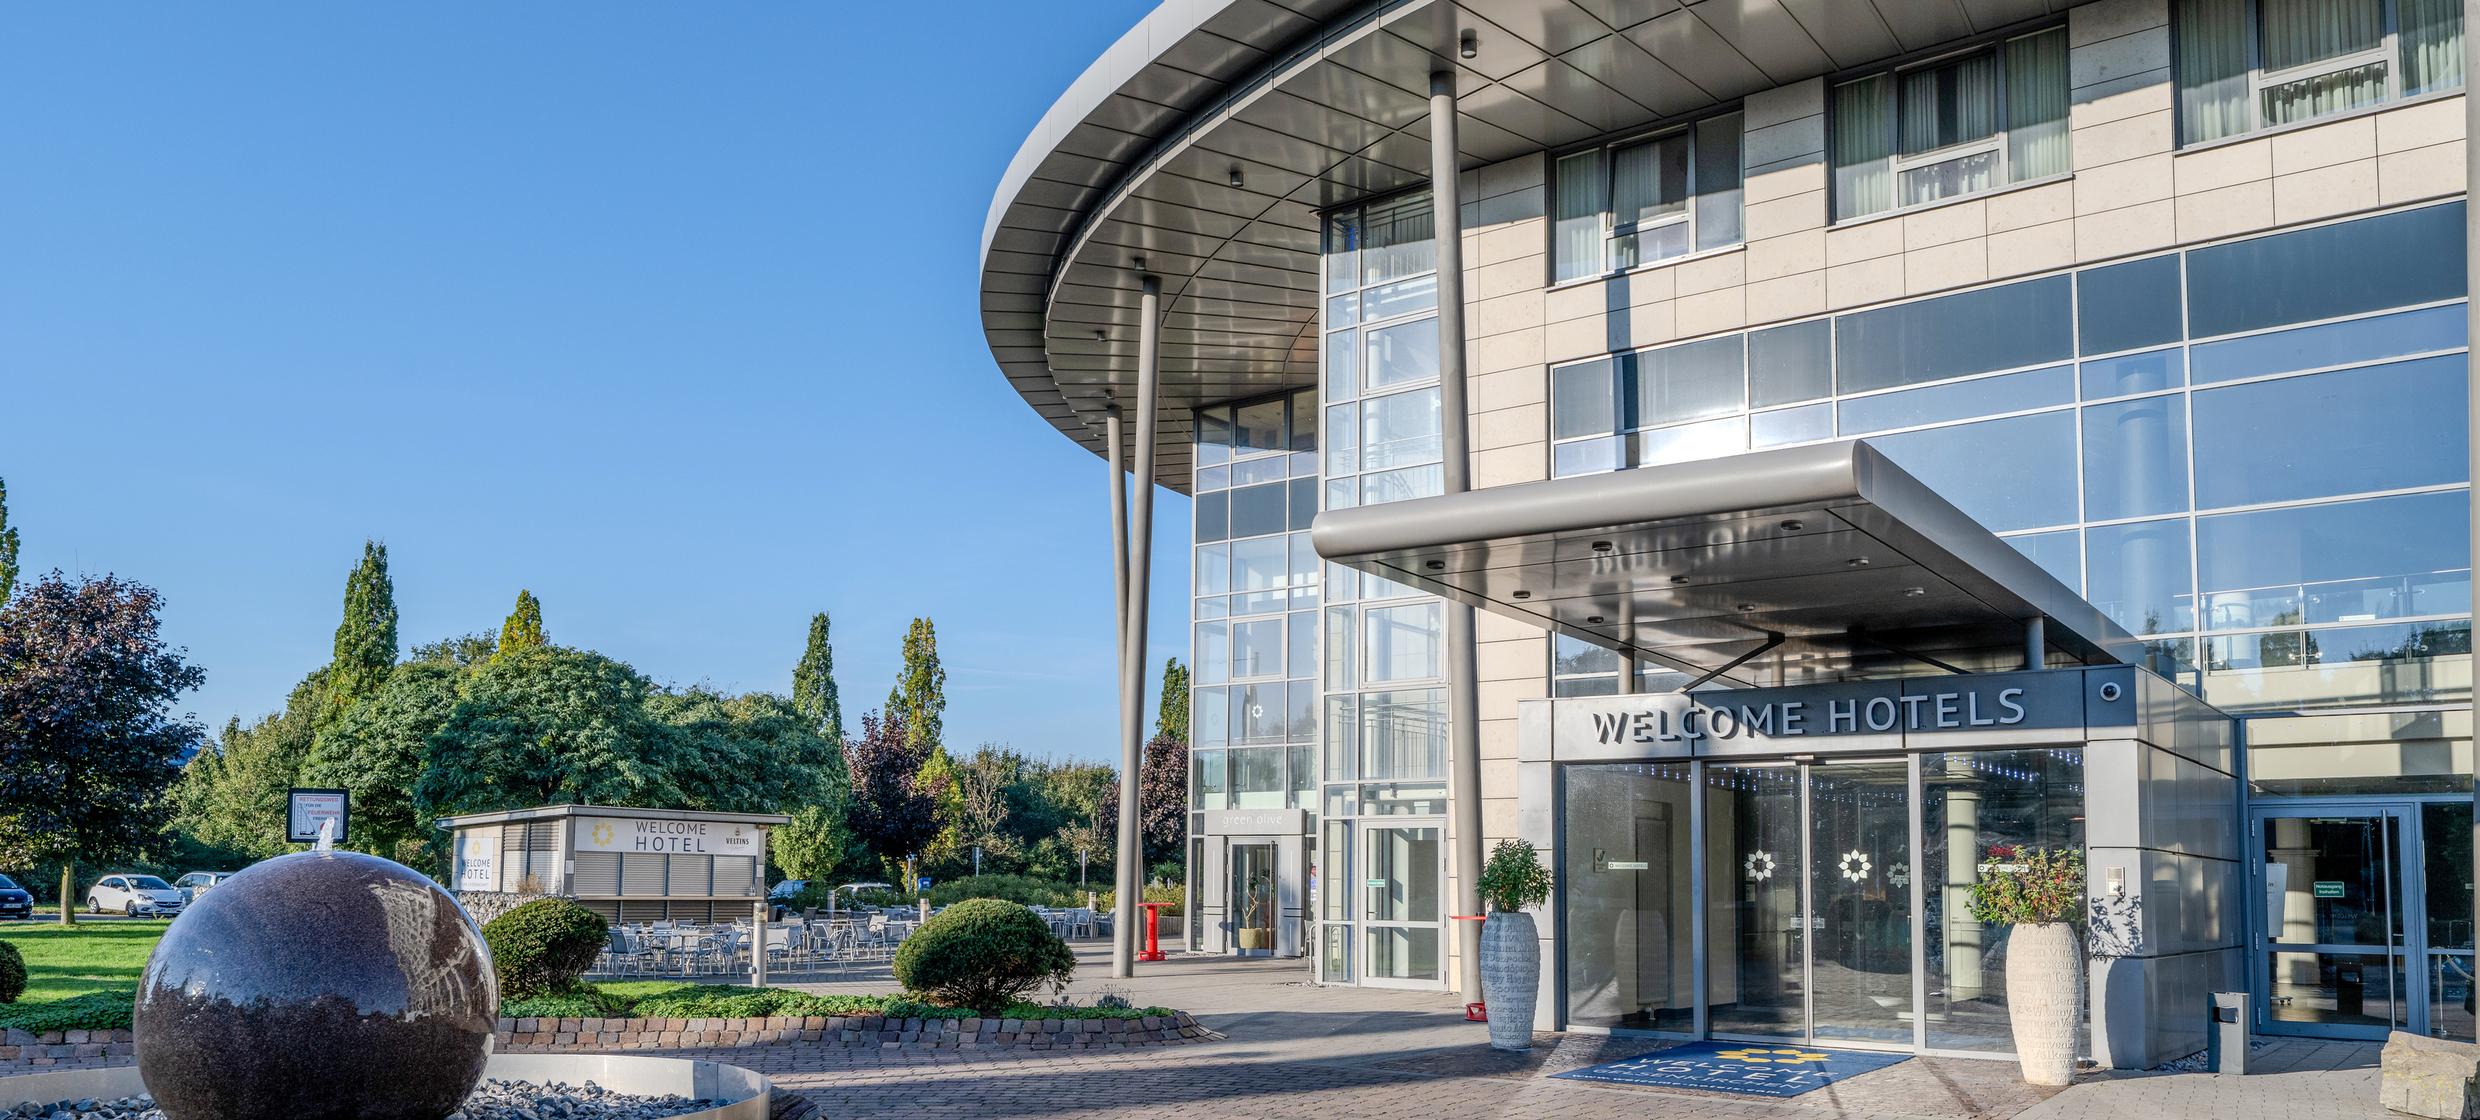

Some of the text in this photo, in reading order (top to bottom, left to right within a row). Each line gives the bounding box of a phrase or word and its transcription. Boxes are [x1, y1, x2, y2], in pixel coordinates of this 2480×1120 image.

[1593, 688, 2025, 745] WELCOME HOTELS
[635, 821, 707, 836] WELCOME
[1222, 813, 1282, 828] green olive
[635, 836, 706, 852] HOTEL
[726, 837, 750, 846] VELTINS
[1607, 1063, 1812, 1085] HOTEL
[1639, 1057, 1839, 1077] WELCOME
[1571, 1074, 1782, 1095] www.welcome-hotels.com
[1592, 1068, 1802, 1089] GELSENKIRCHEN
